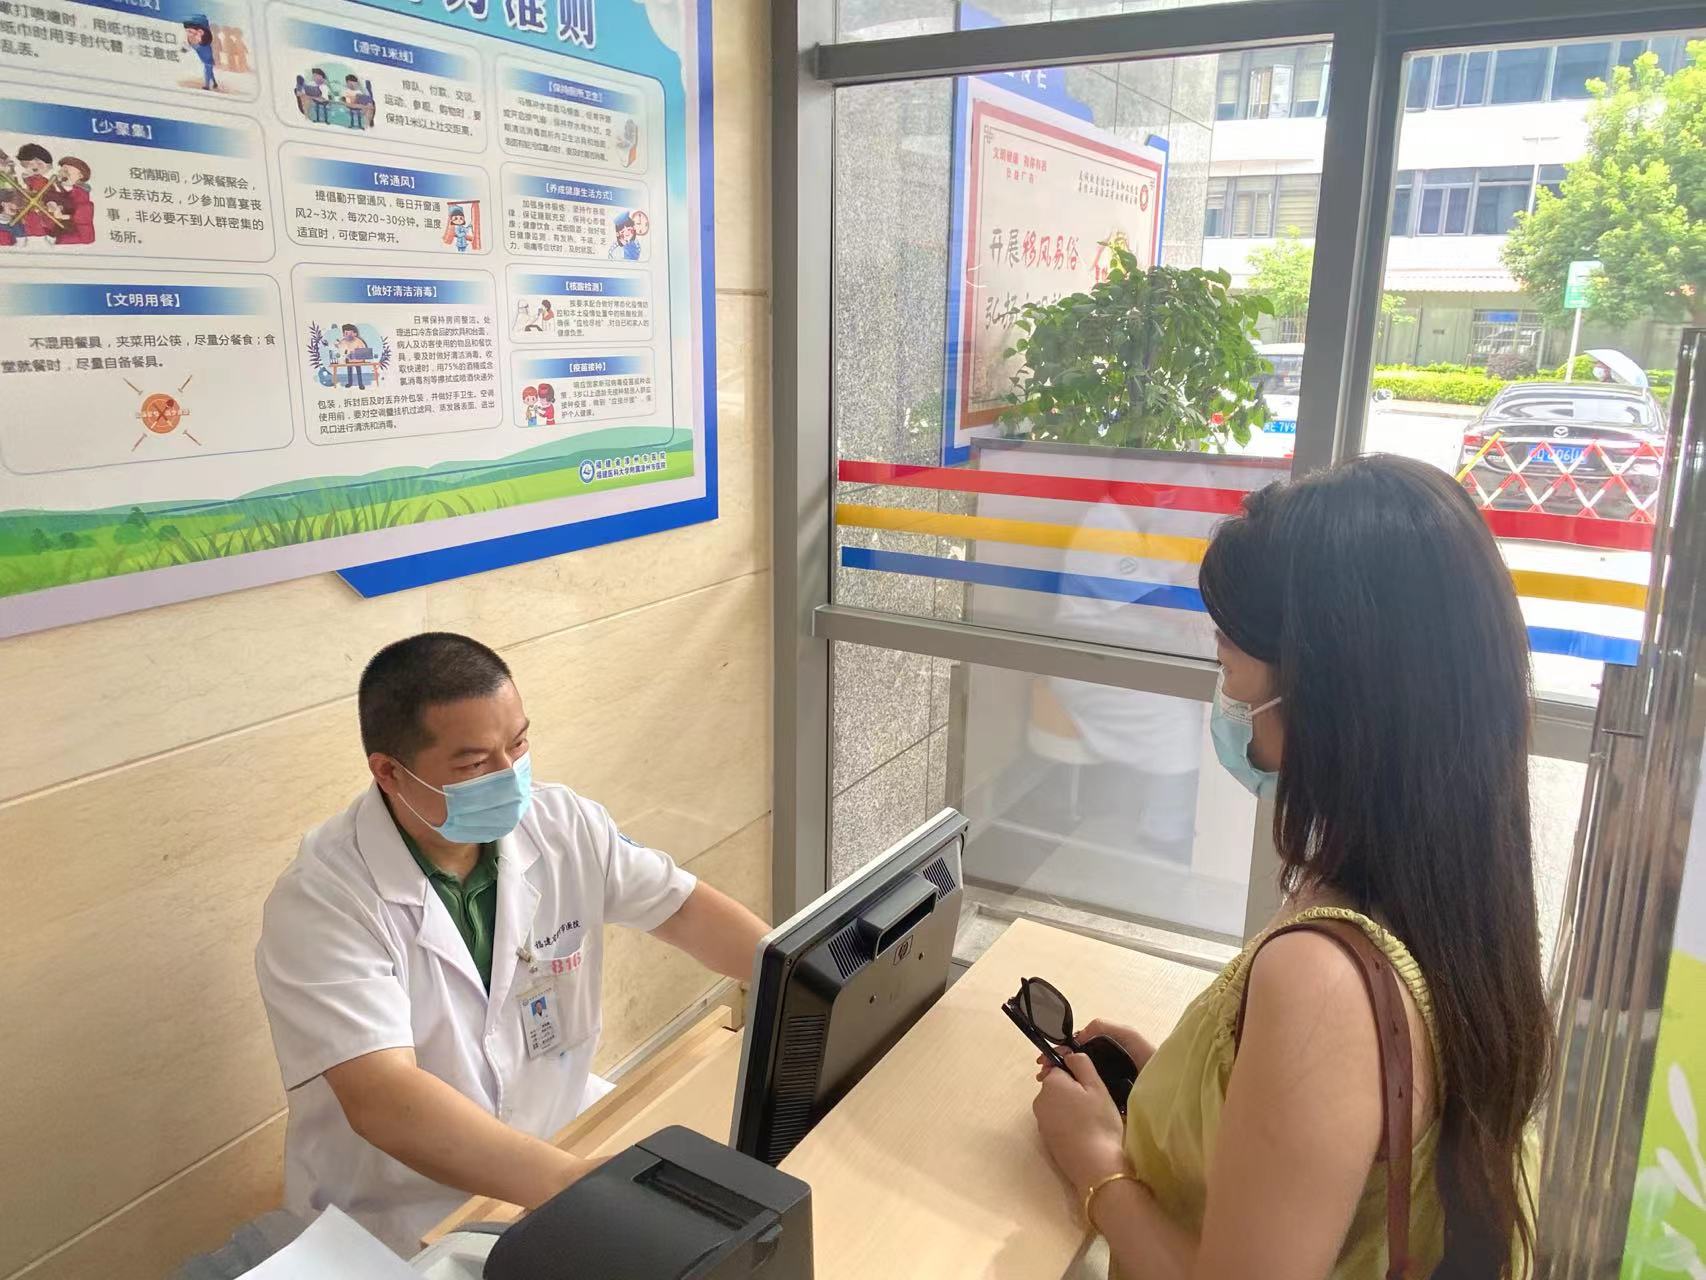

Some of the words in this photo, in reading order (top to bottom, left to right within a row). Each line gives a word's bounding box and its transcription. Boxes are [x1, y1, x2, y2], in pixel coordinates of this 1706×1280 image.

[91, 118, 152, 140] 【少聚集】
[373, 172, 416, 189] 【常通风】
[104, 186, 263, 211] 少走亲访友，少参加喜宴丧
[106, 208, 264, 232] 事，非必要不到人群密集的
[109, 229, 144, 245] 场所。
[297, 226, 400, 245] 适宜时，可使窗户常开。
[105, 292, 181, 308] 【文明用餐】
[365, 285, 438, 298] 【做好清洁消毒】
[320, 421, 398, 435] 风口进行清洗和消毒。
